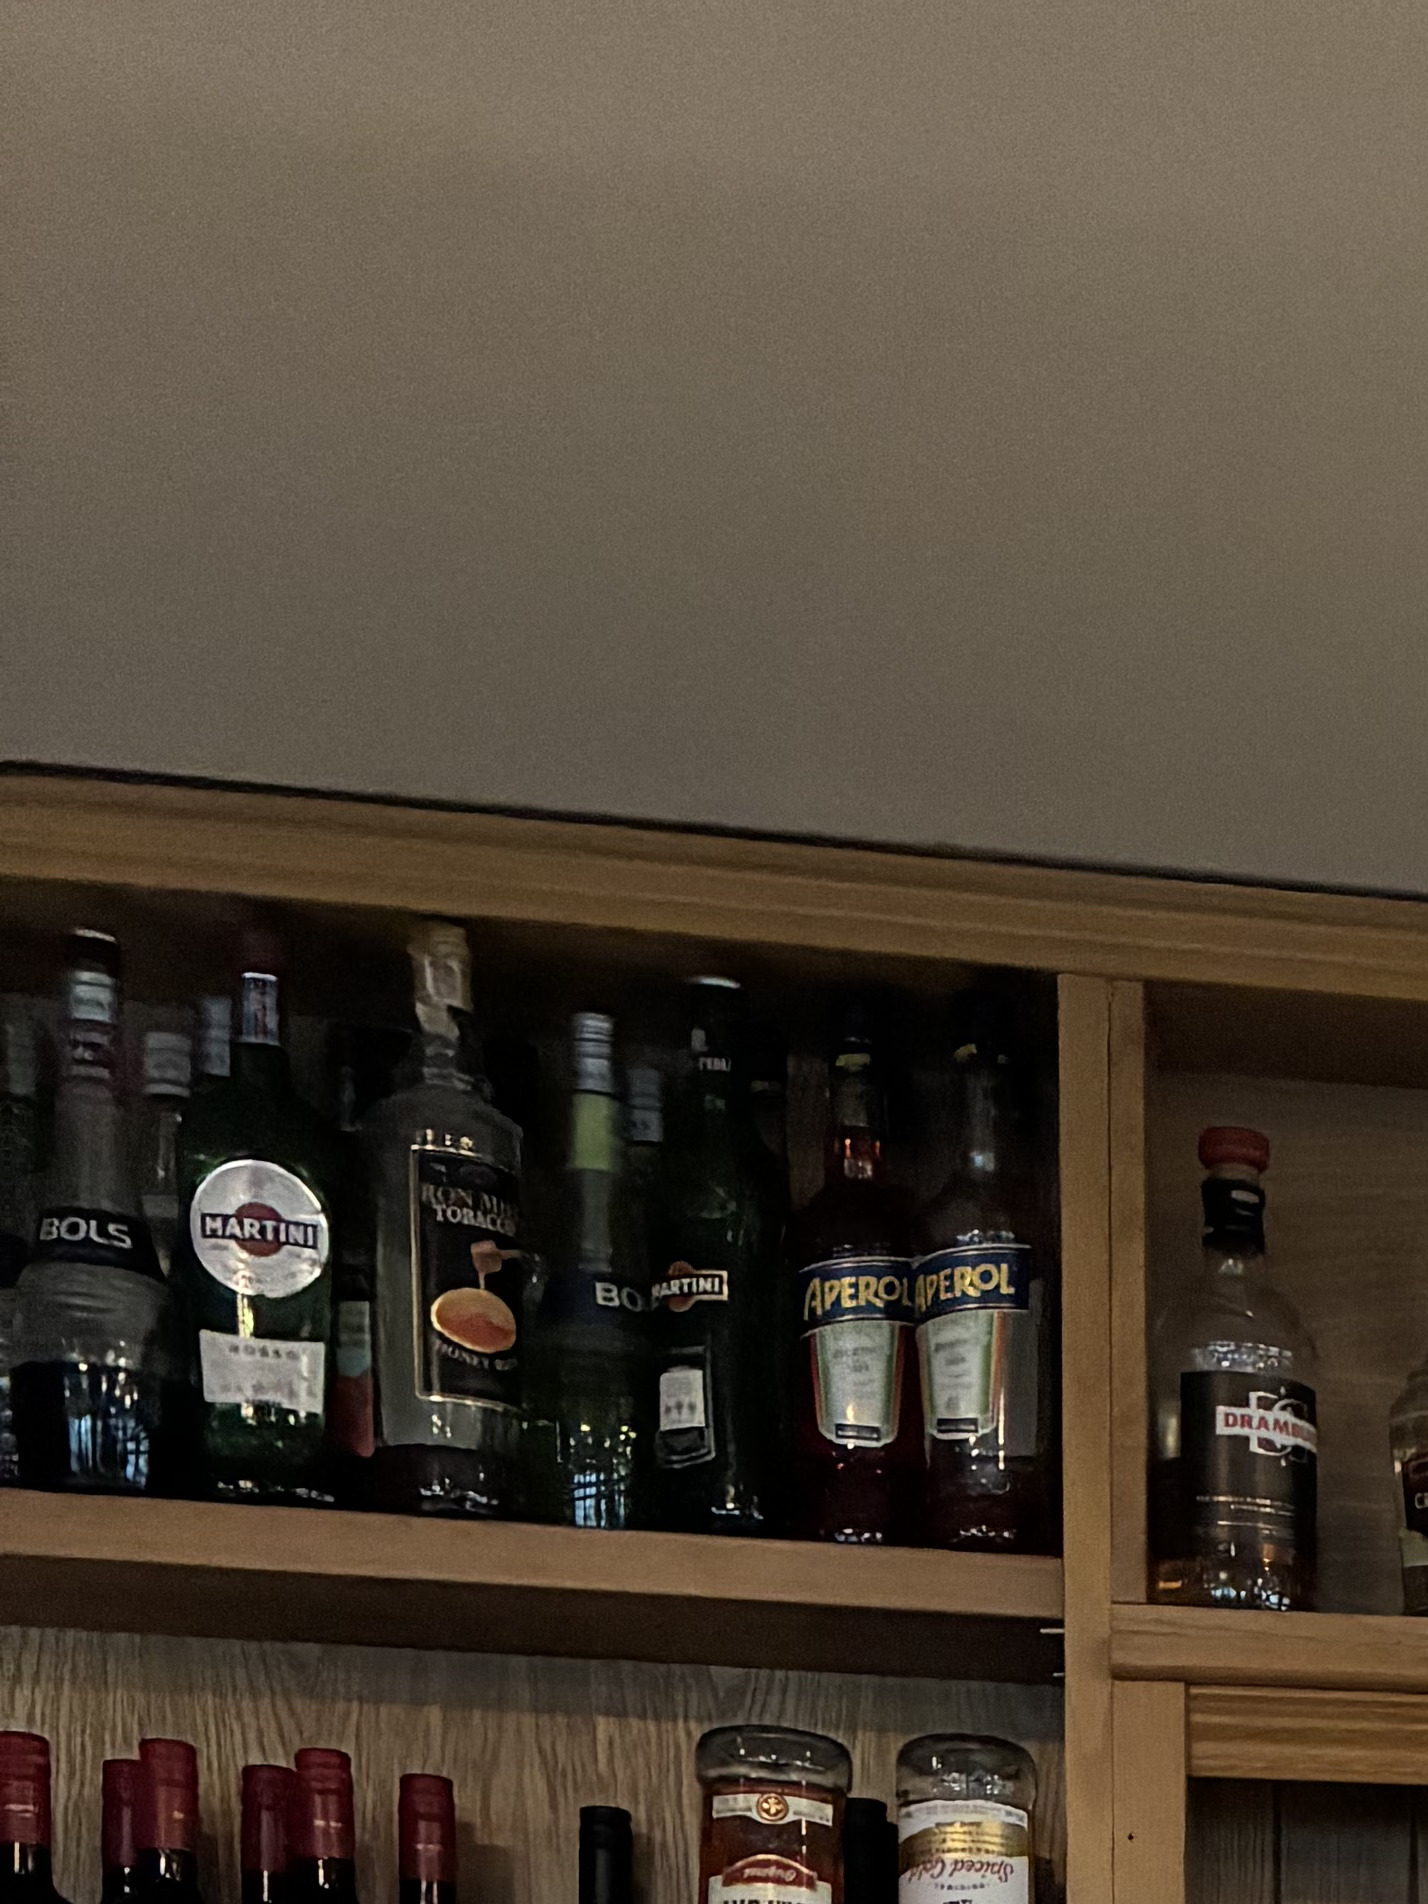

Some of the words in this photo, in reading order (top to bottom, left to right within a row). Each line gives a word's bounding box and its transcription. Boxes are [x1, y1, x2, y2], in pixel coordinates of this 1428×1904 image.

[40, 1217, 133, 1249] BOLS
[205, 1215, 315, 1247] MARTINI
[803, 1275, 912, 1321] APEROL
[915, 1264, 1016, 1314] APEROL
[950, 1859, 1015, 1883] Spiced
